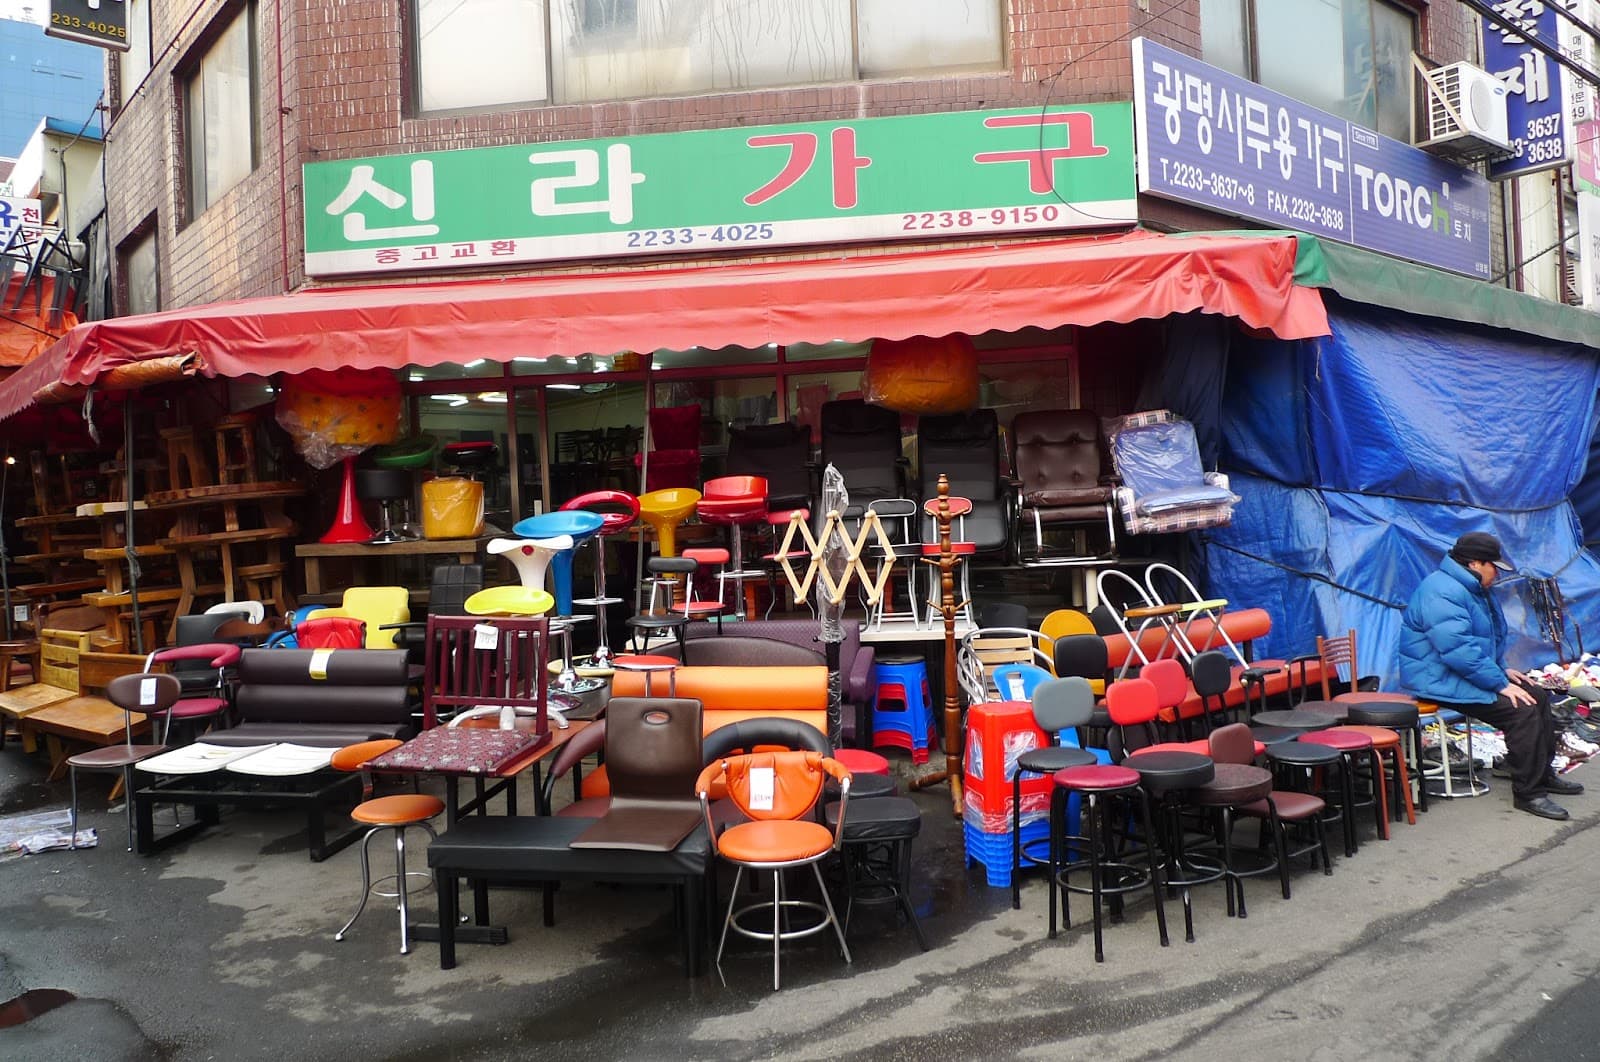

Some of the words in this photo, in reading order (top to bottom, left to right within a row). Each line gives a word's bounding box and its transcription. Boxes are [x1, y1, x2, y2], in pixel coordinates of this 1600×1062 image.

[1152, 60, 1345, 194] 광명사무용가구
[903, 205, 1059, 231] 2238-9150
[1454, 219, 1472, 242] 토치
[627, 222, 774, 249] 2233-4025
[375, 239, 518, 264] 중고교환
